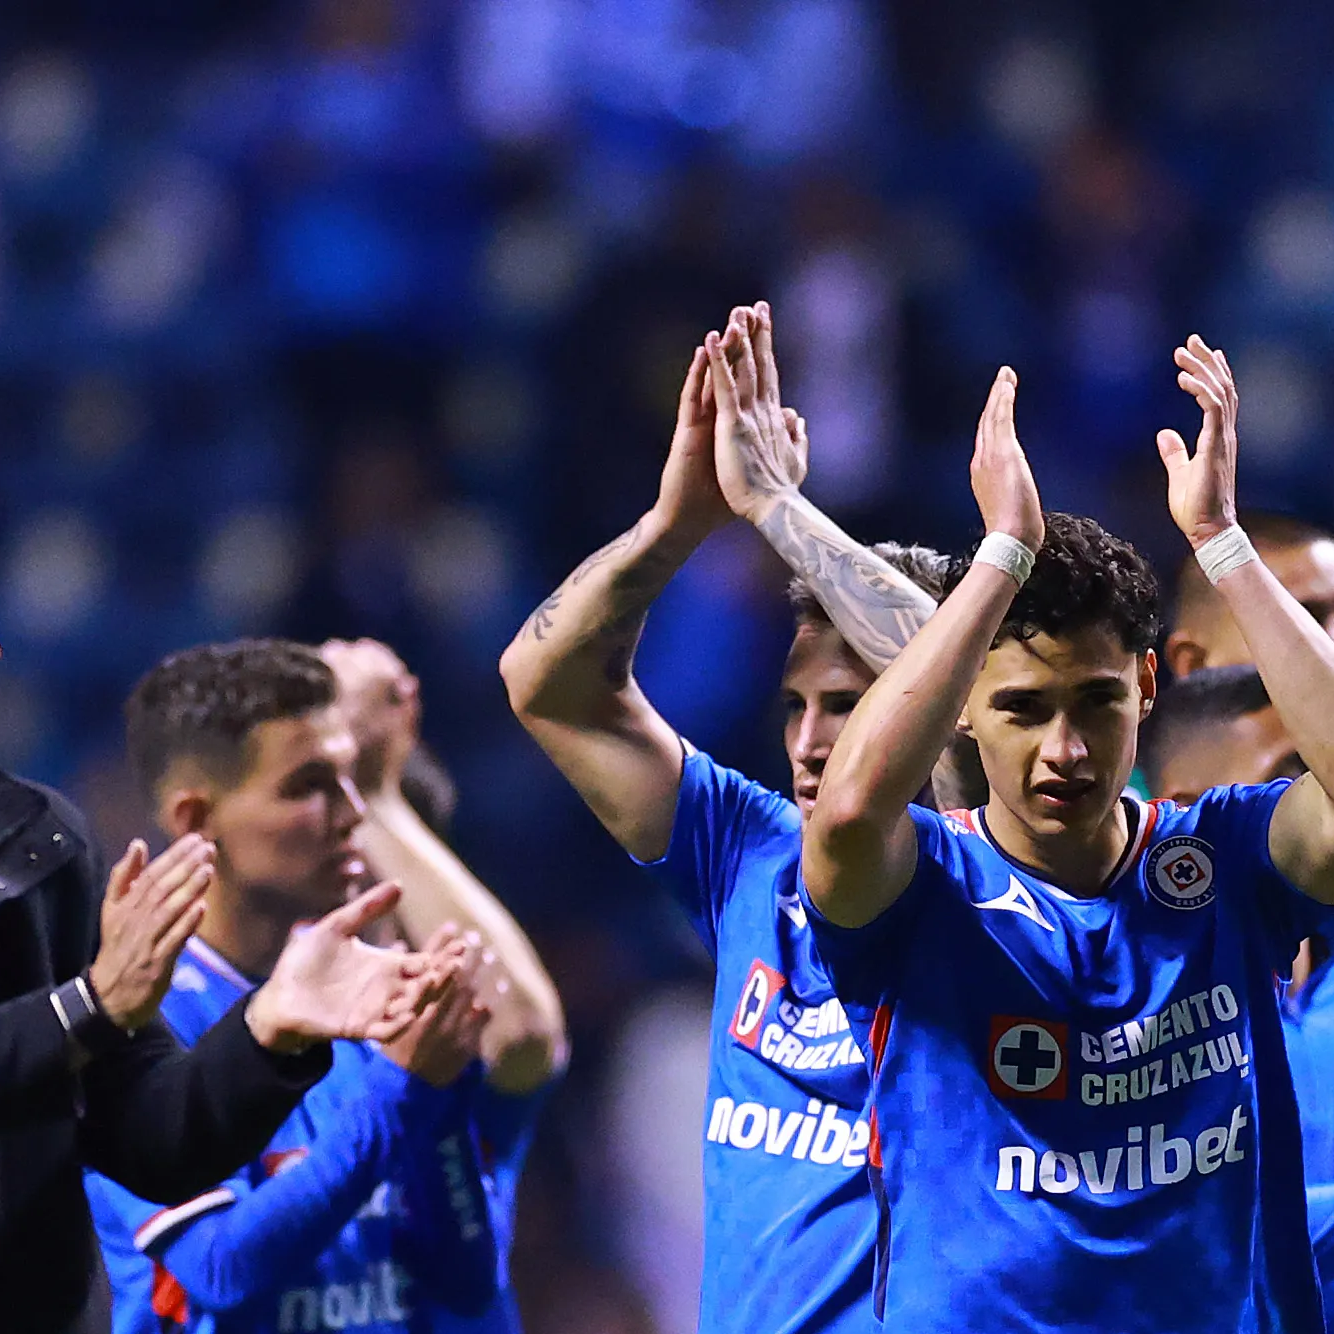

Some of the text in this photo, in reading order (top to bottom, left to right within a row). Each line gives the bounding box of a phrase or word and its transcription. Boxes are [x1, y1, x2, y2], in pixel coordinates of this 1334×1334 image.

[1080, 983, 1239, 1064] CEMENTO
[706, 1096, 870, 1168] novibe
[995, 1103, 1247, 1194] novibet
